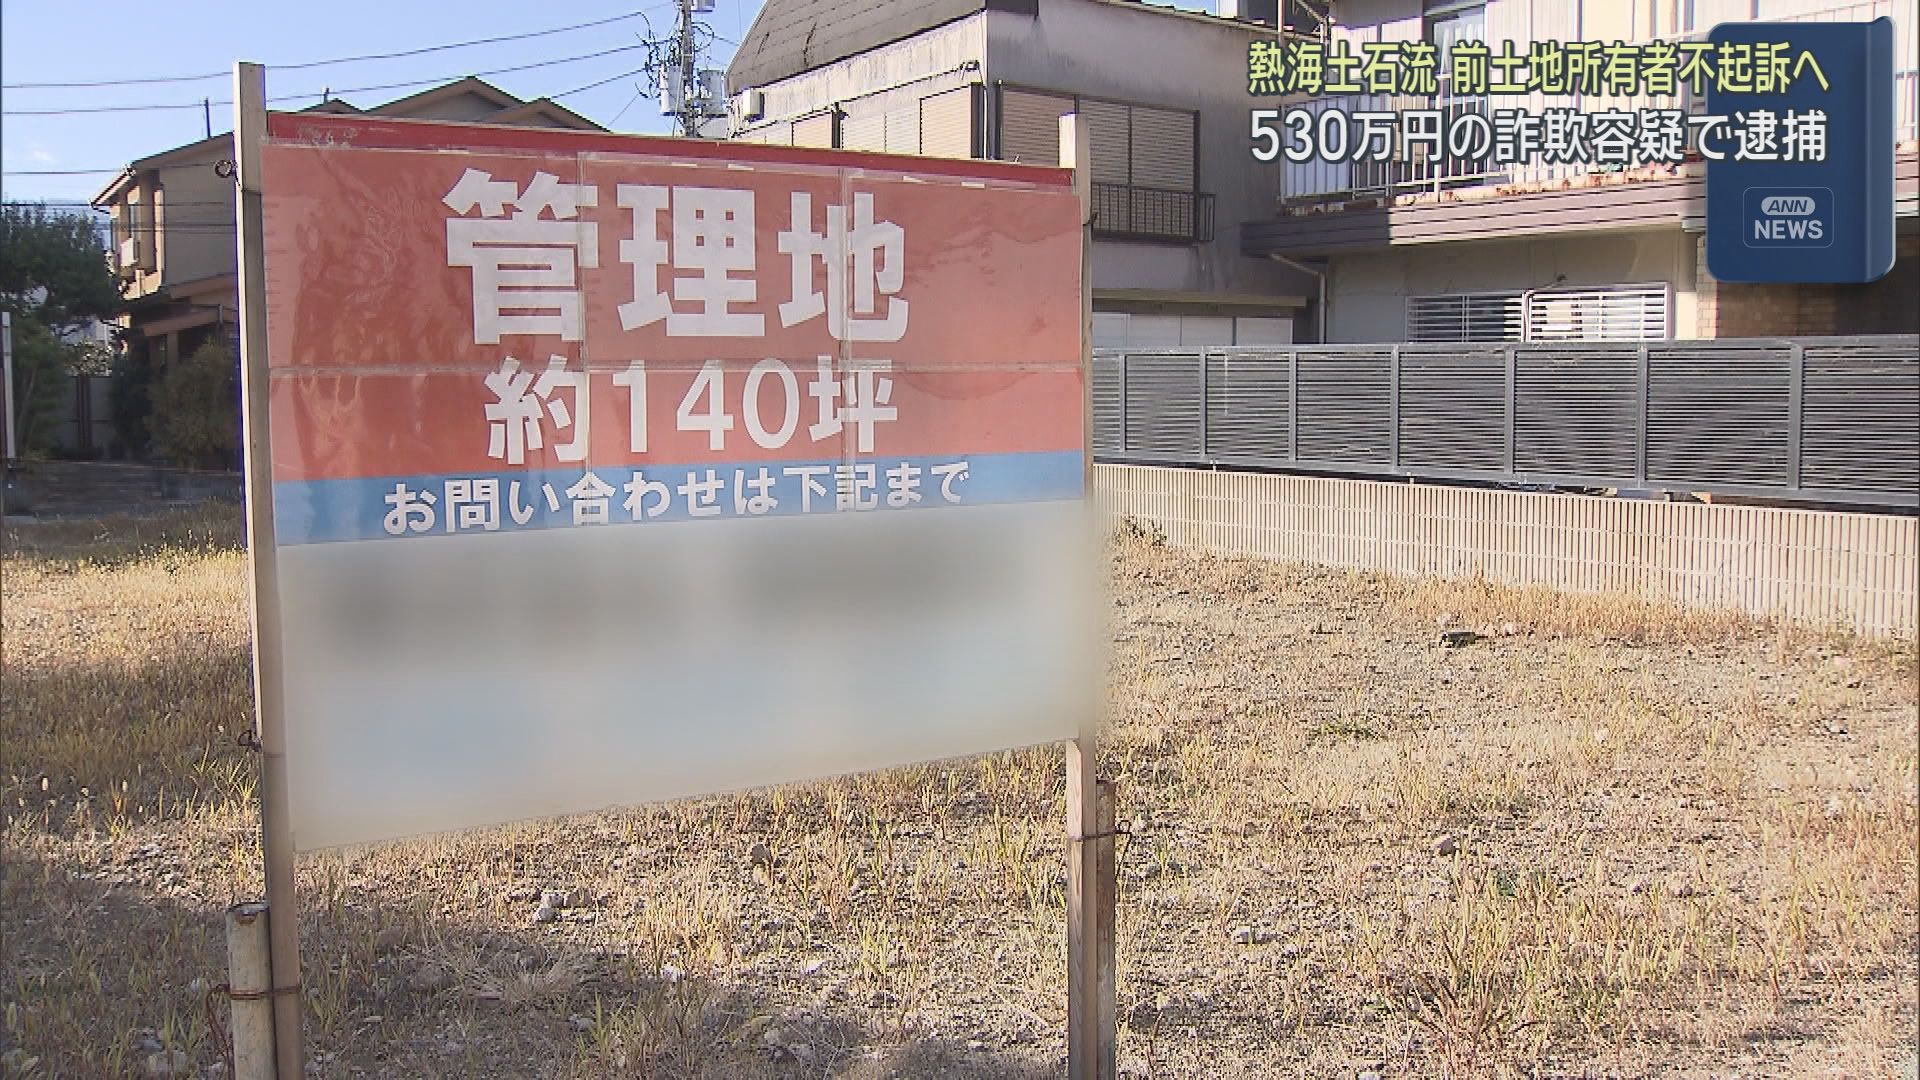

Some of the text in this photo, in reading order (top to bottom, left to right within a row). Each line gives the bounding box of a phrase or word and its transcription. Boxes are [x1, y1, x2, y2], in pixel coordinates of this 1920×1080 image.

[443, 168, 909, 345] 管理地
[484, 354, 898, 466] 約140坪
[383, 461, 970, 536] お問い合わせは下記まで
